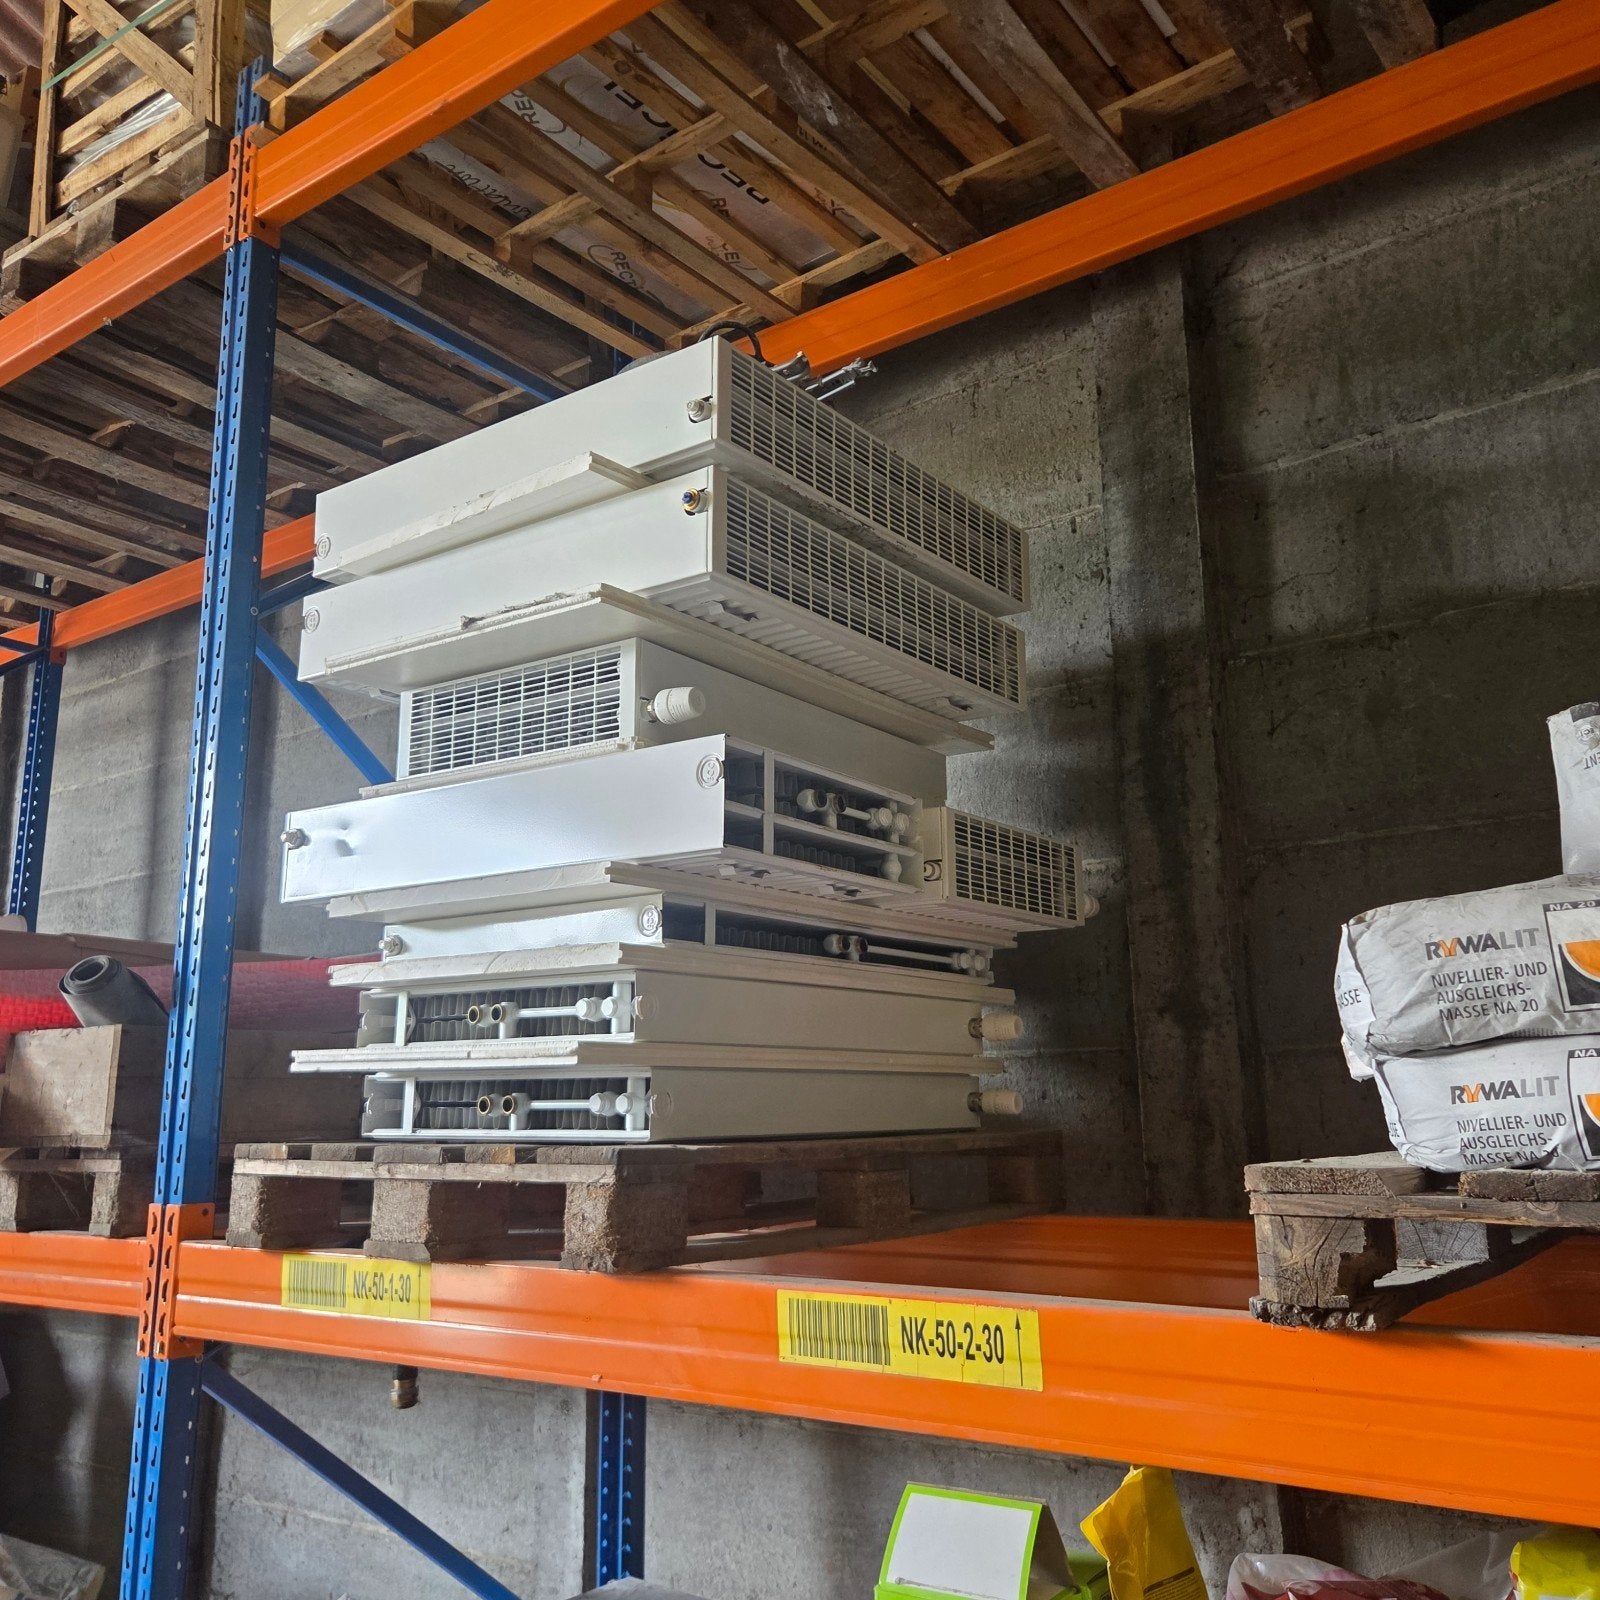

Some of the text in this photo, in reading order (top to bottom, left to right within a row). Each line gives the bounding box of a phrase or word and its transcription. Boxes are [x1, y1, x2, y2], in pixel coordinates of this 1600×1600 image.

[1549, 900, 1596, 911] NA 20
[1425, 928, 1539, 961] RYWALIT
[1431, 961, 1547, 988] NIVELLIER- UND
[1436, 981, 1531, 1005] AUSGLEICHS-
[1439, 998, 1539, 1022] MASSE NA 20
[1574, 1049, 1598, 1058] NA
[1450, 1076, 1560, 1105] RYWALIT
[1457, 1112, 1567, 1134] NIVELLIER- UND
[1459, 1132, 1552, 1151] AUSGLEICHS-
[1462, 1152, 1514, 1166] MASSE
[1518, 1150, 1537, 1162] NA
[353, 1270, 412, 1304] NK-50-1-30
[900, 1315, 1005, 1365] NK-50-2-30
